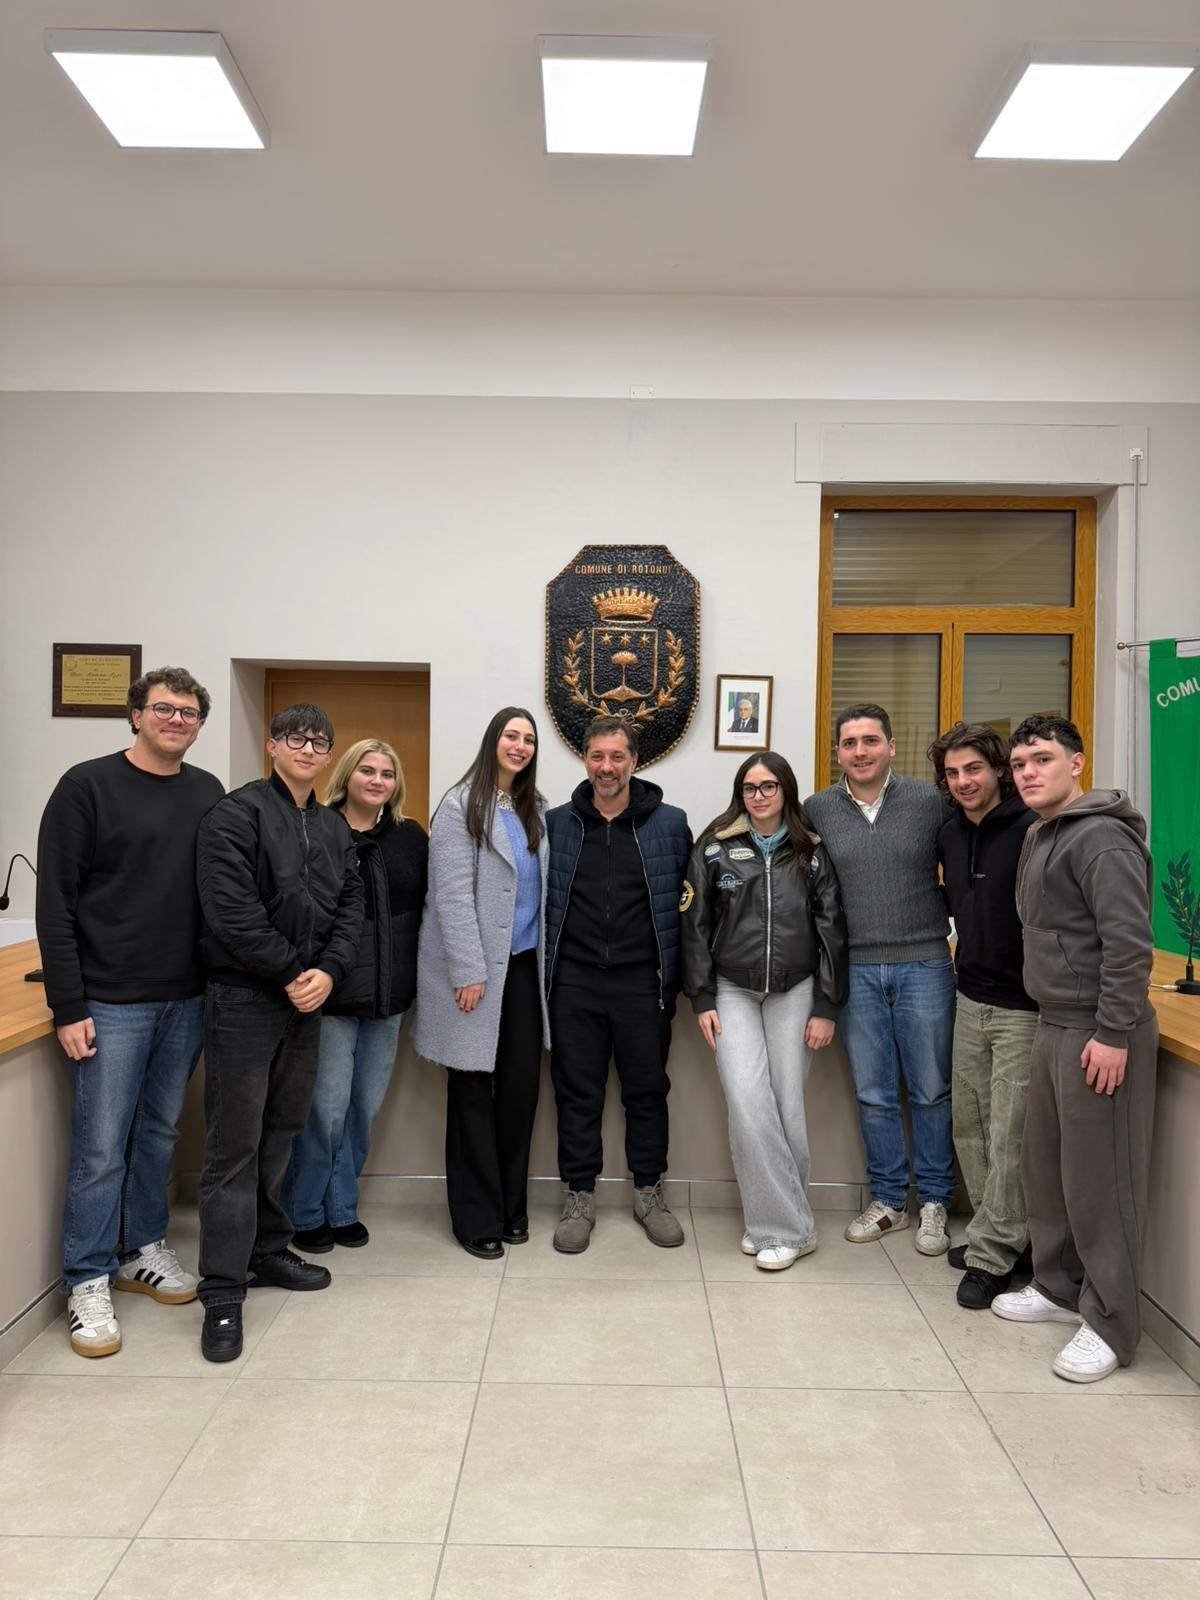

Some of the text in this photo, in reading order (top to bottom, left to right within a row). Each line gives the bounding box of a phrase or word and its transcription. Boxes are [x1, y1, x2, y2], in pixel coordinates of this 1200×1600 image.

[575, 564, 671, 574] COMUNE DI ROTONDI
